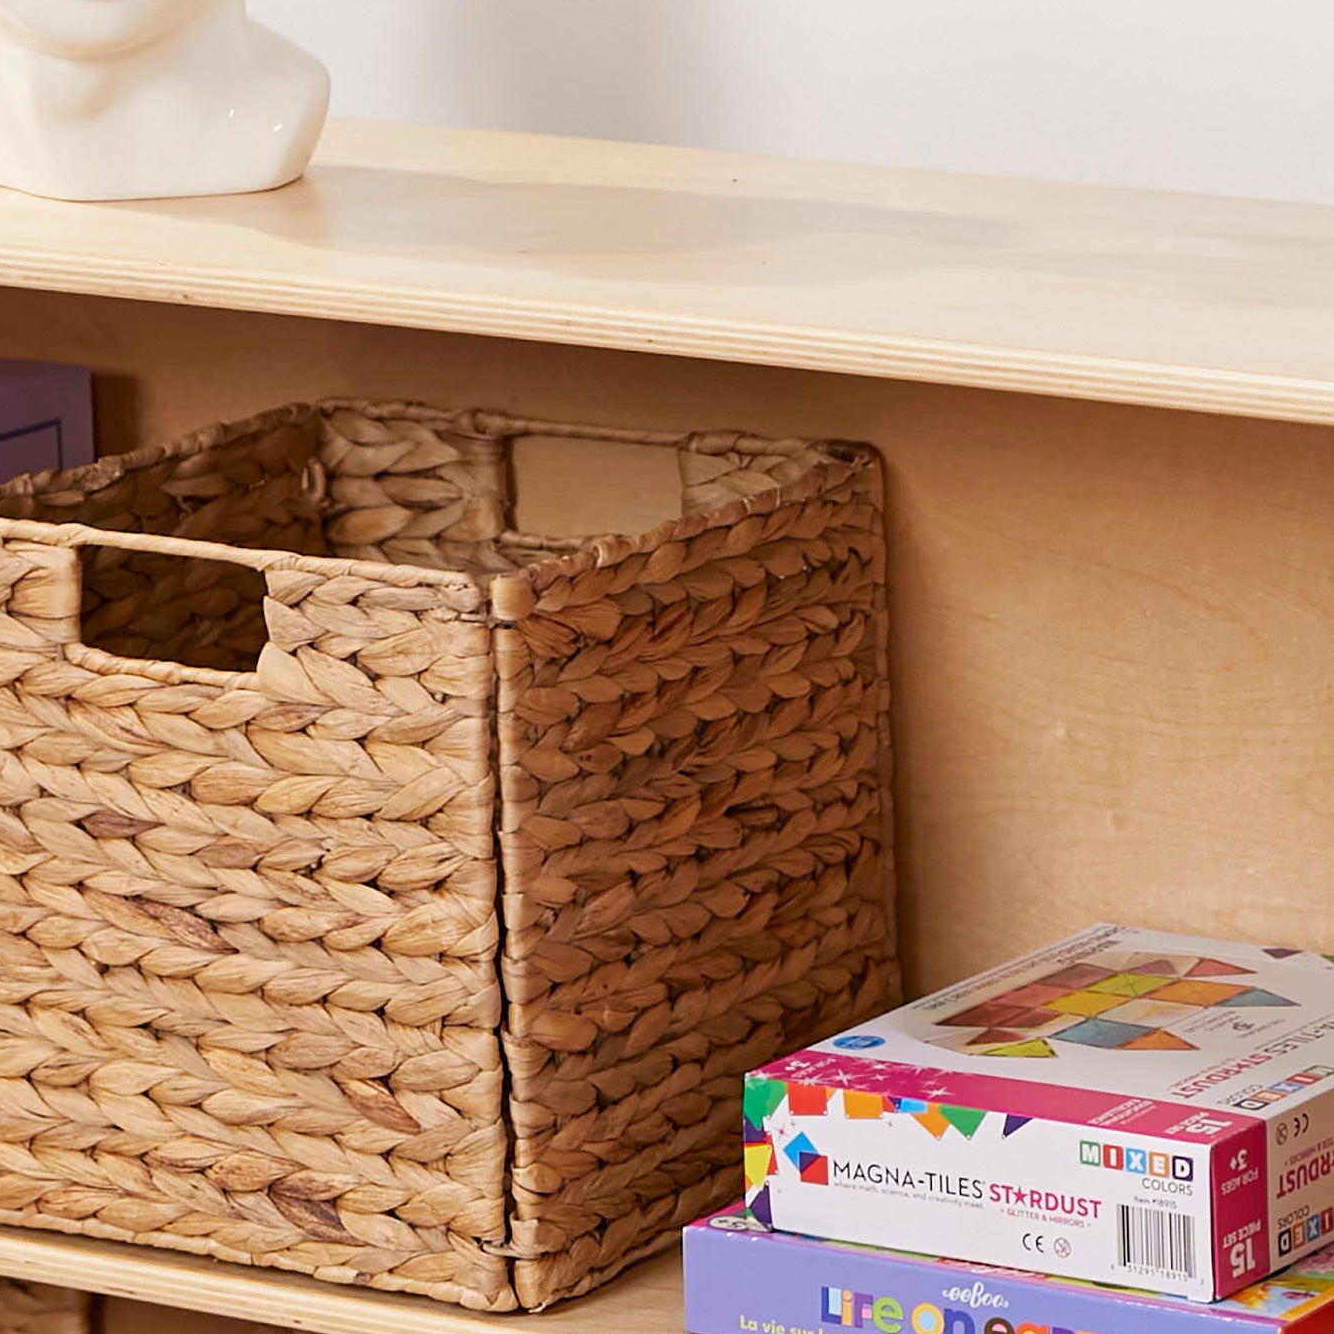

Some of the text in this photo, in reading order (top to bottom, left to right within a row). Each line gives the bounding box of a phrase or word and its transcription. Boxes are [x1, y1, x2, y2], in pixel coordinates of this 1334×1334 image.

[1186, 1117, 1233, 1135] 15
[1080, 1140, 1194, 1182] MIXED
[1229, 1148, 1249, 1172] 3+
[1141, 1177, 1193, 1196] COLORS
[1220, 1166, 1260, 1197] FOR AGES
[1277, 1204, 1310, 1229] COLORS
[1222, 1219, 1262, 1249] PIECE SET
[1229, 1237, 1256, 1279] 15
[739, 1314, 758, 1332] La
